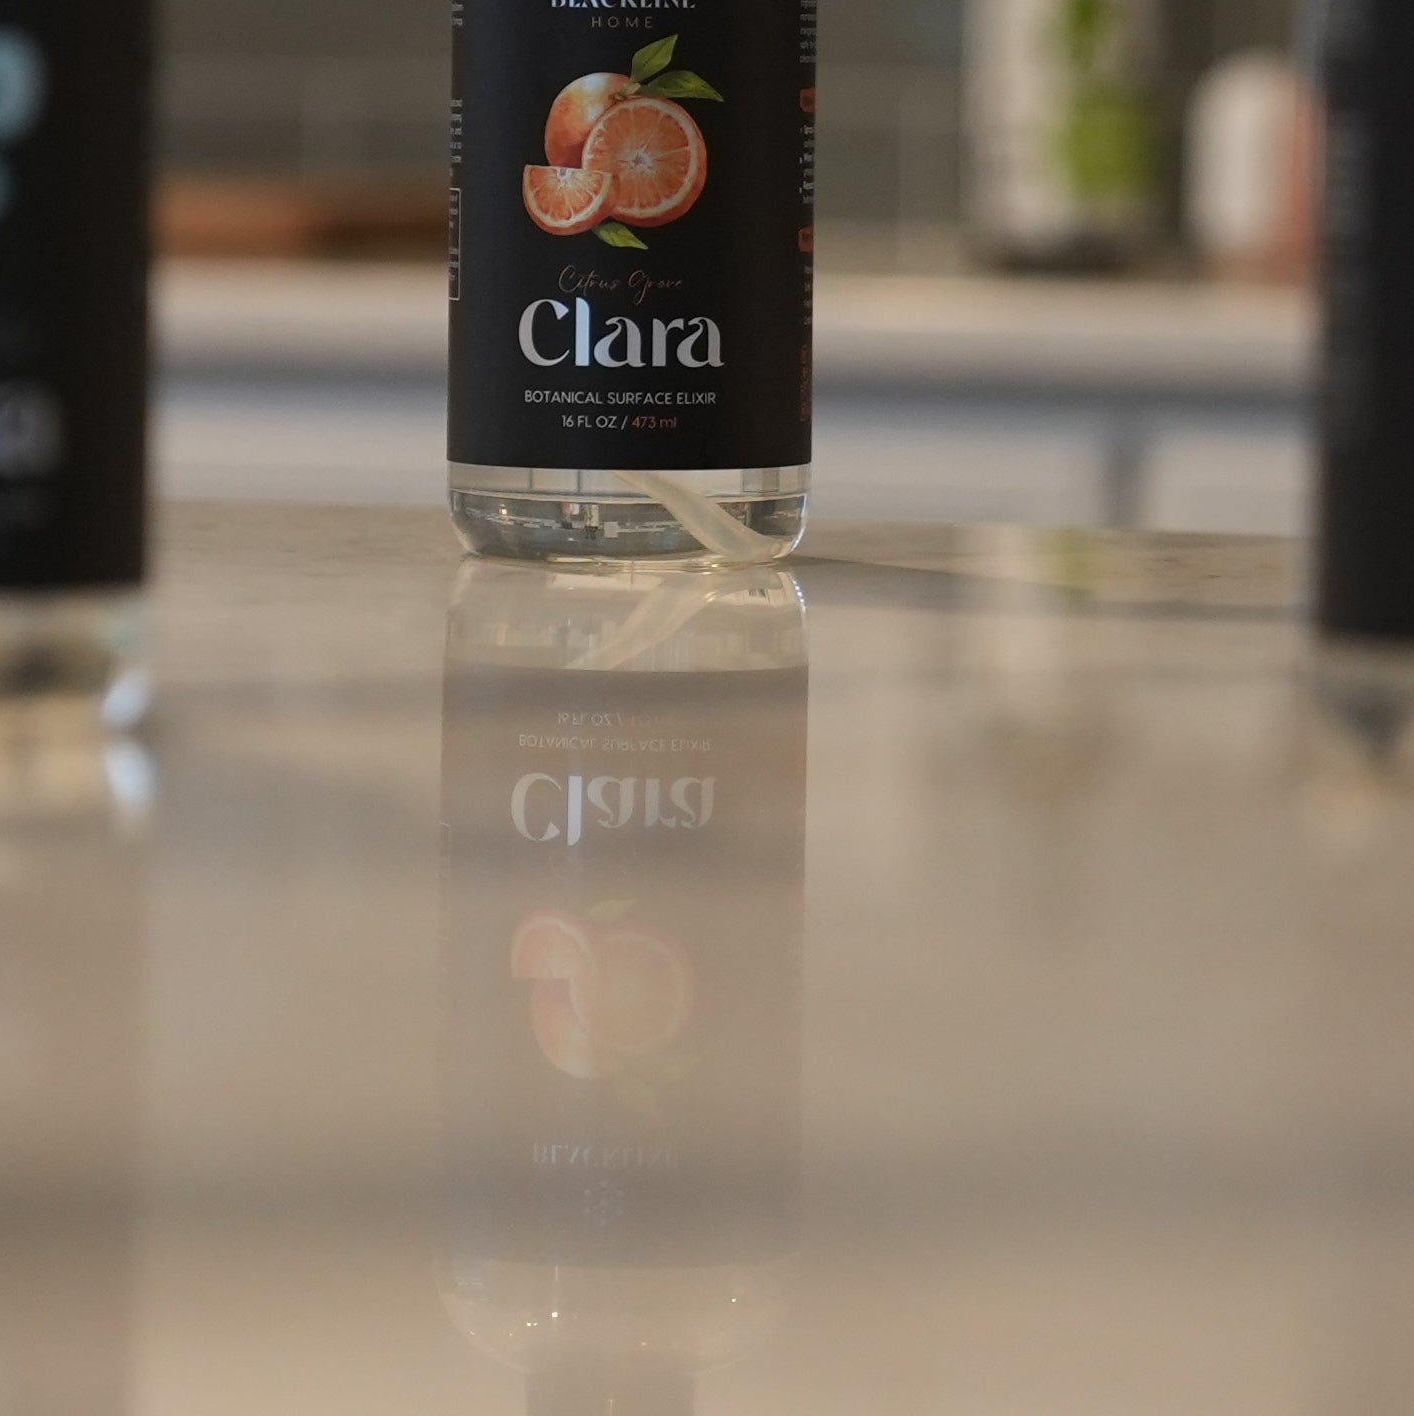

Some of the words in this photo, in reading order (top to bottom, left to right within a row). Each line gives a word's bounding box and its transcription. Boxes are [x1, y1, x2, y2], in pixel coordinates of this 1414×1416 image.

[591, 15, 653, 29] HOME
[558, 264, 621, 296] Citrus
[627, 270, 682, 306] Grove
[518, 296, 725, 368] Clara
[524, 389, 603, 405] BOTANICAL
[607, 391, 672, 405] SURFACE
[676, 391, 716, 405] ELIXIR
[561, 414, 575, 429] 16
[577, 415, 592, 429] FL
[595, 415, 618, 429] OZ
[620, 415, 629, 430] /
[632, 415, 657, 429] 473
[659, 415, 677, 429] ml
